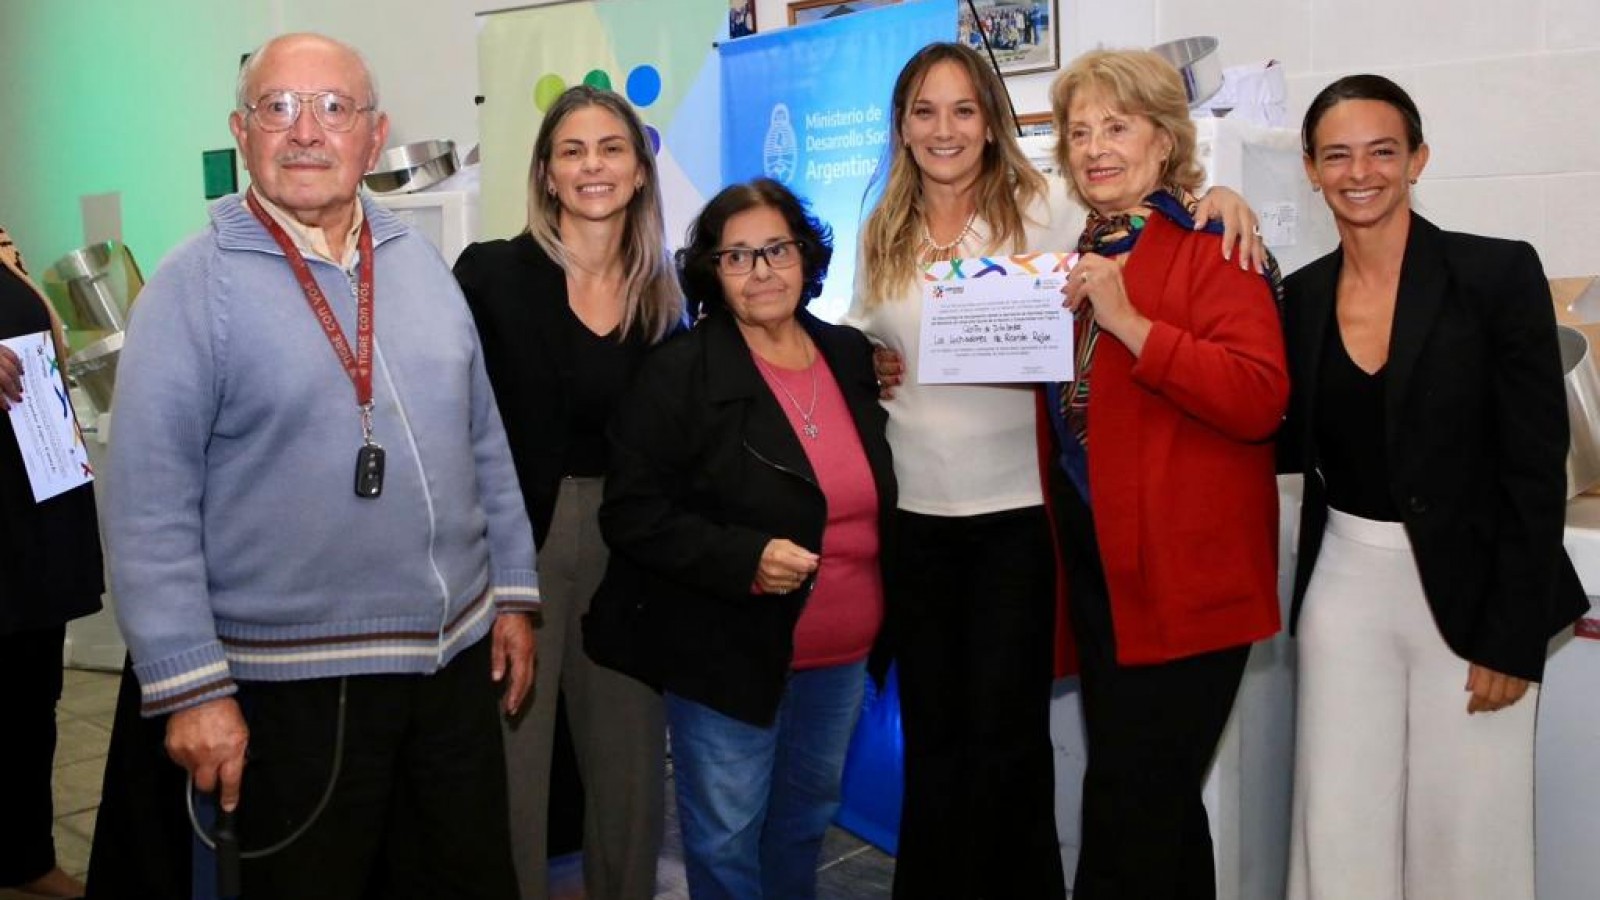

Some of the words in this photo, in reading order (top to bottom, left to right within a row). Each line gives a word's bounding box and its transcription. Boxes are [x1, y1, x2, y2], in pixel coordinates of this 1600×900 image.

[805, 107, 864, 129] Ministerio
[866, 104, 882, 121] de
[805, 129, 864, 152] Desarrollo
[866, 128, 889, 146] Soc
[359, 282, 370, 304] VOS
[358, 335, 369, 365] TIGRE
